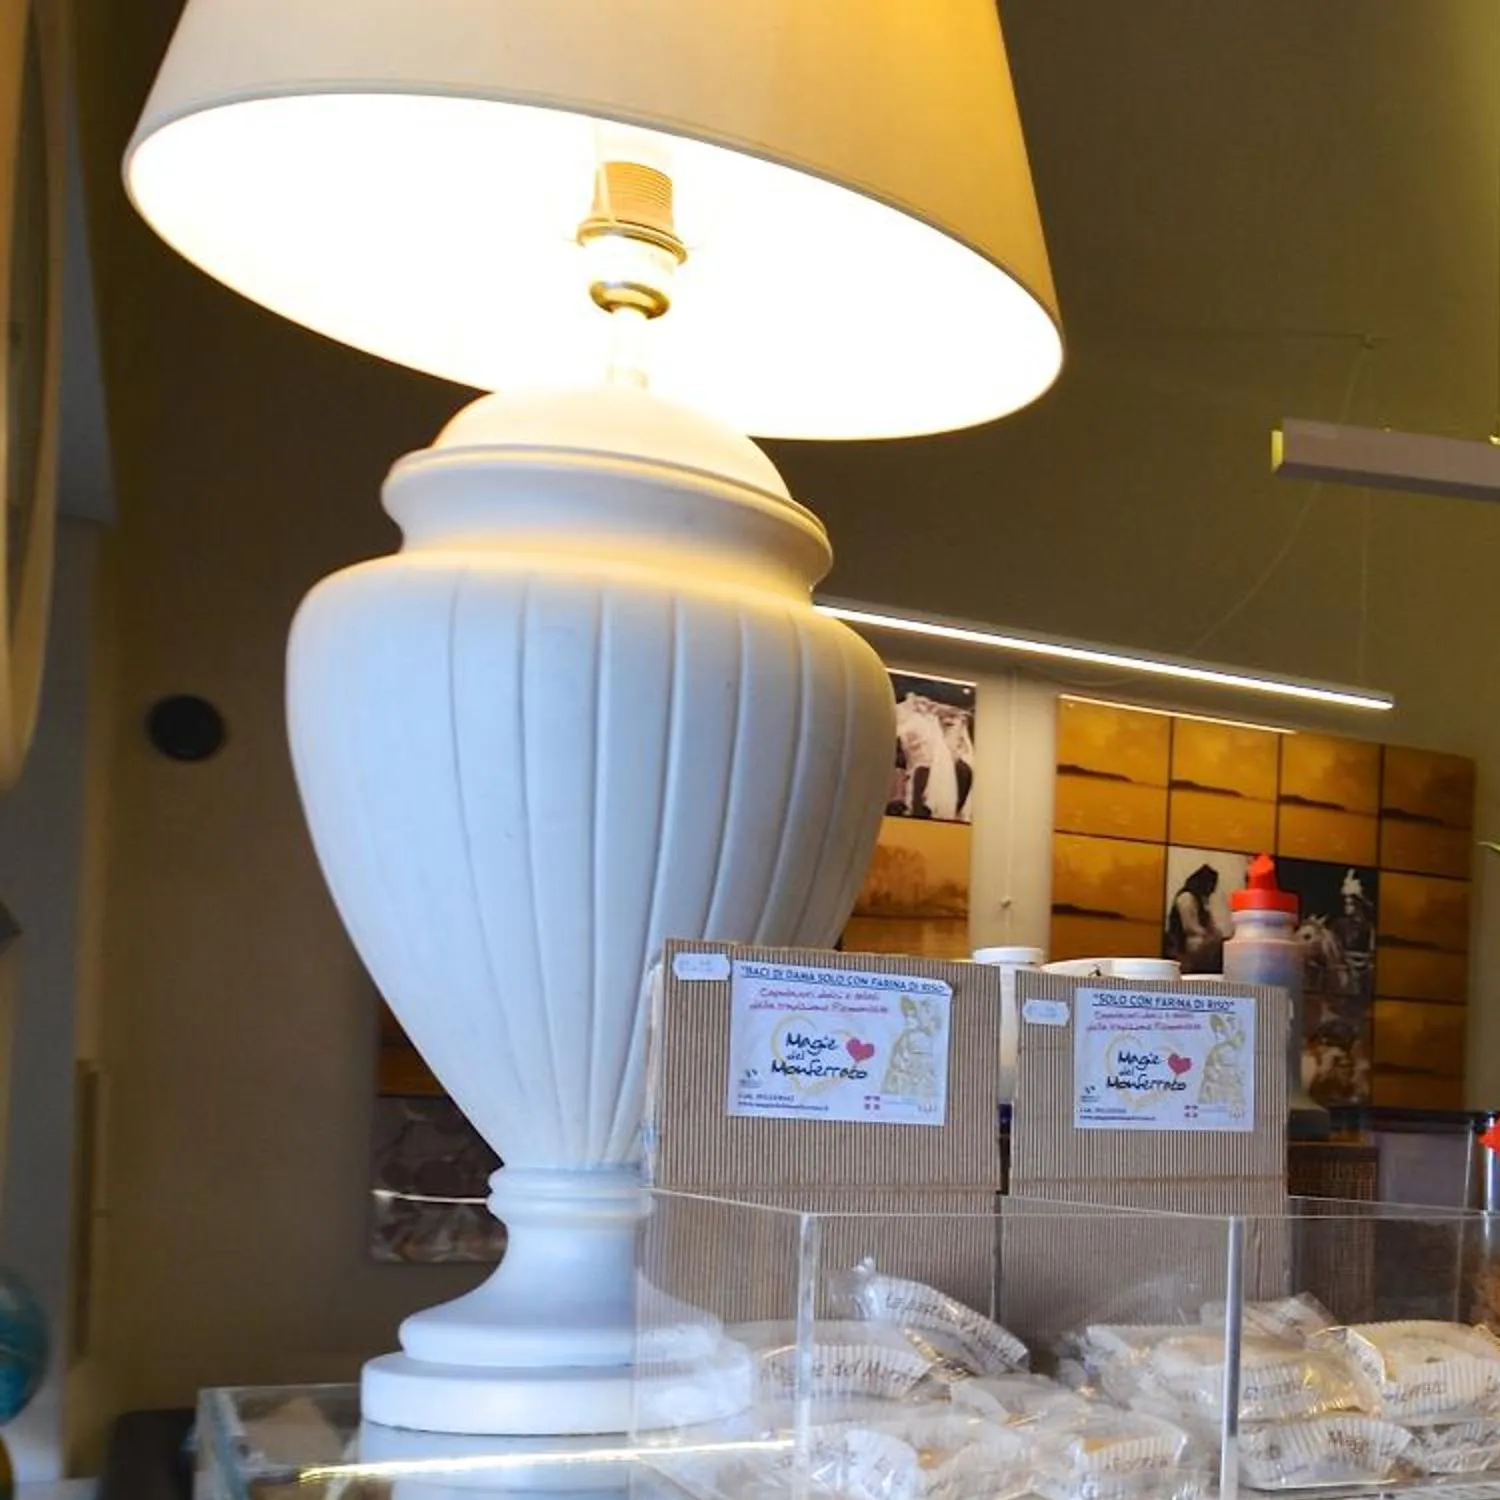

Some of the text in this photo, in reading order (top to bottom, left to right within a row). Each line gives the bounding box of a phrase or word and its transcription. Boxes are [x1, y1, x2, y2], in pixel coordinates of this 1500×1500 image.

[1129, 994, 1152, 1007] CON
[786, 1032, 837, 1056] Magie
[771, 1059, 868, 1080] Monferrato
[1117, 1050, 1161, 1070] Magie
[1106, 1073, 1187, 1092] Monferrato
